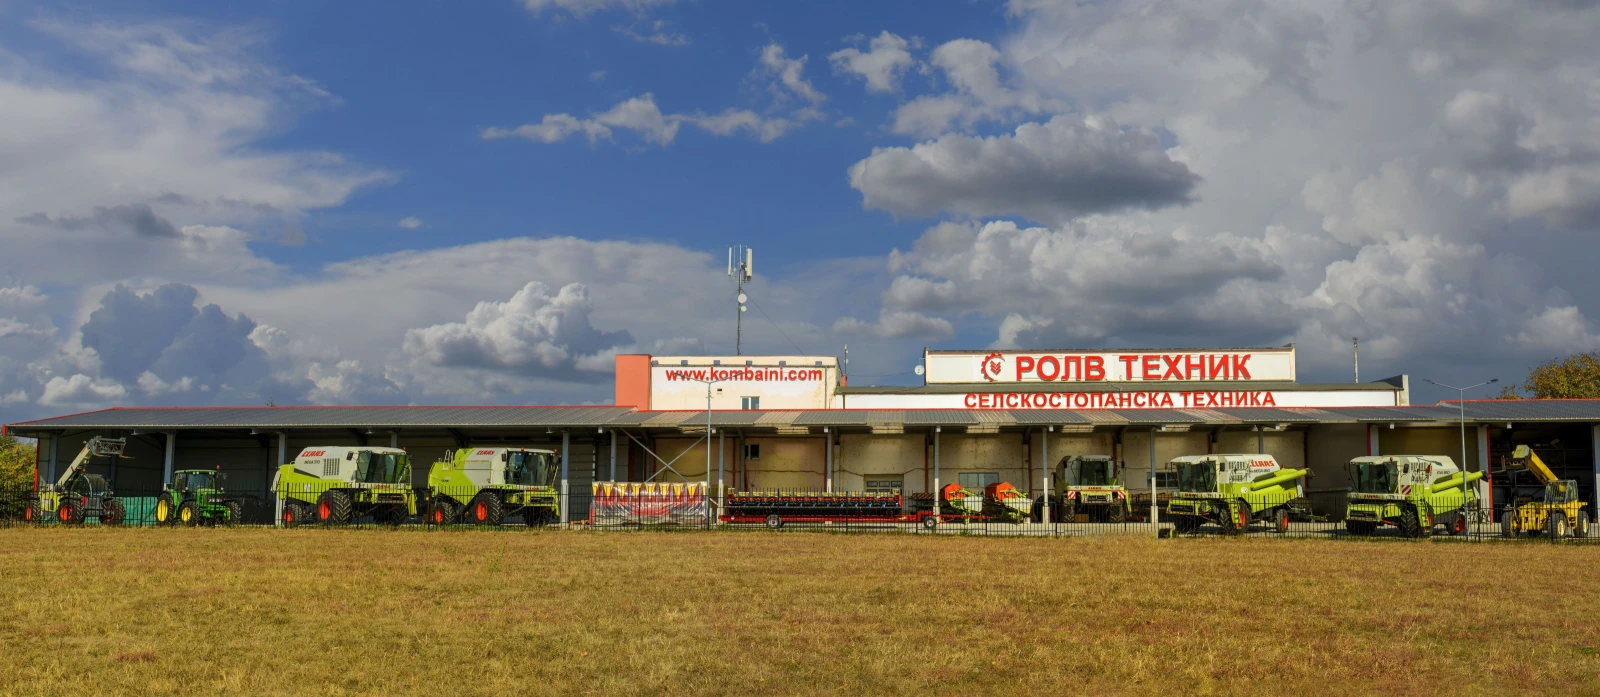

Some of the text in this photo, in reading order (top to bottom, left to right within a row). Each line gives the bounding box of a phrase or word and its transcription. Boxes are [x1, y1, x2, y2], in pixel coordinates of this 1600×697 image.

[665, 366, 823, 382] www.kombaini.com
[1015, 353, 1252, 382] РОЛВ ТЕХНИК
[963, 391, 1276, 409] СЕЛСКОСТОПАНСКА ТЕХНИКА
[301, 450, 327, 458] CLAAS
[1250, 459, 1275, 468] CLAAS
